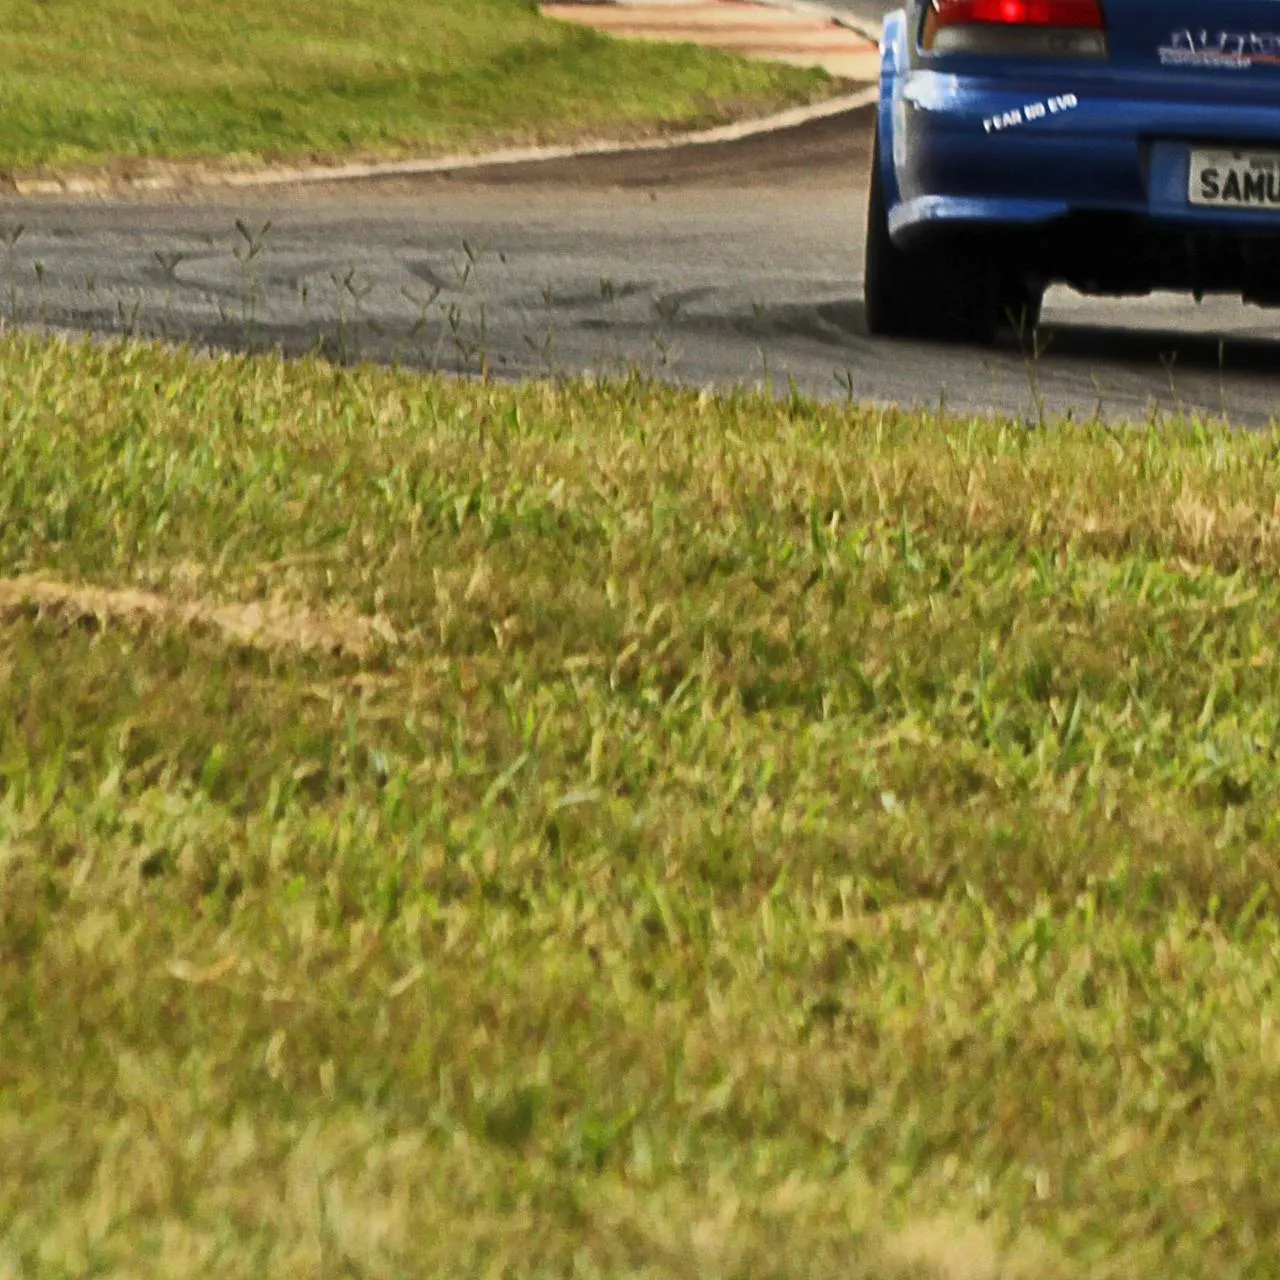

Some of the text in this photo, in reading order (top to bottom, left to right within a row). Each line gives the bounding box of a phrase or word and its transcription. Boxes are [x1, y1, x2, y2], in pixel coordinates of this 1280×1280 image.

[983, 93, 1079, 133] FEAR NO EVO
